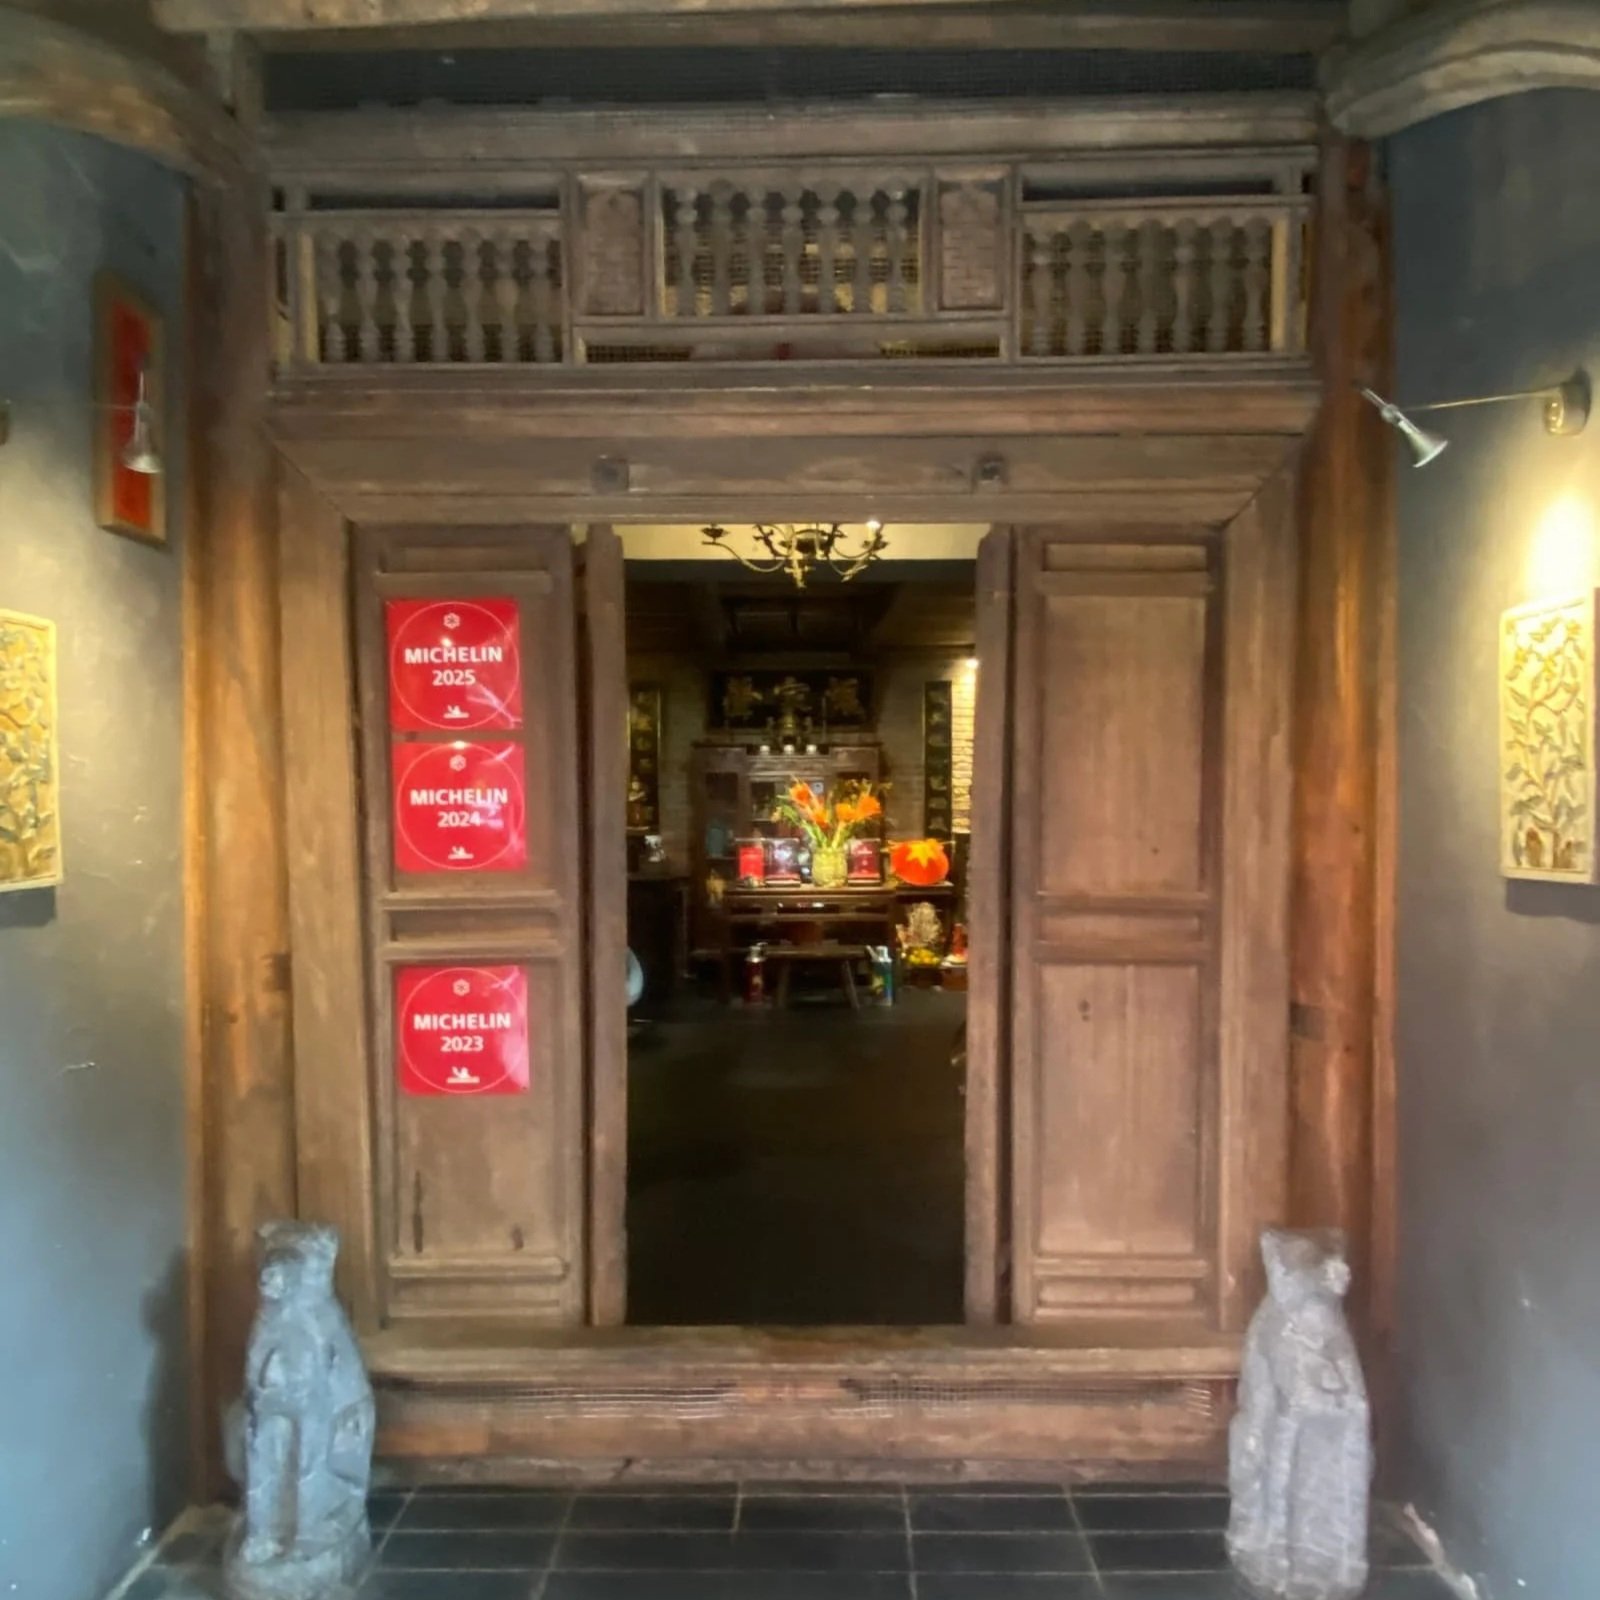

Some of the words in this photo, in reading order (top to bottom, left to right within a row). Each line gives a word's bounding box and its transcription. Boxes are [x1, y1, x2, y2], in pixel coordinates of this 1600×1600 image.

[404, 646, 503, 664] MICHELIN
[432, 670, 476, 686] 2025
[410, 788, 508, 806] MICHELIN
[437, 811, 481, 828] 2024
[413, 1012, 511, 1031] MICHELIN
[440, 1035, 484, 1053] 2023
